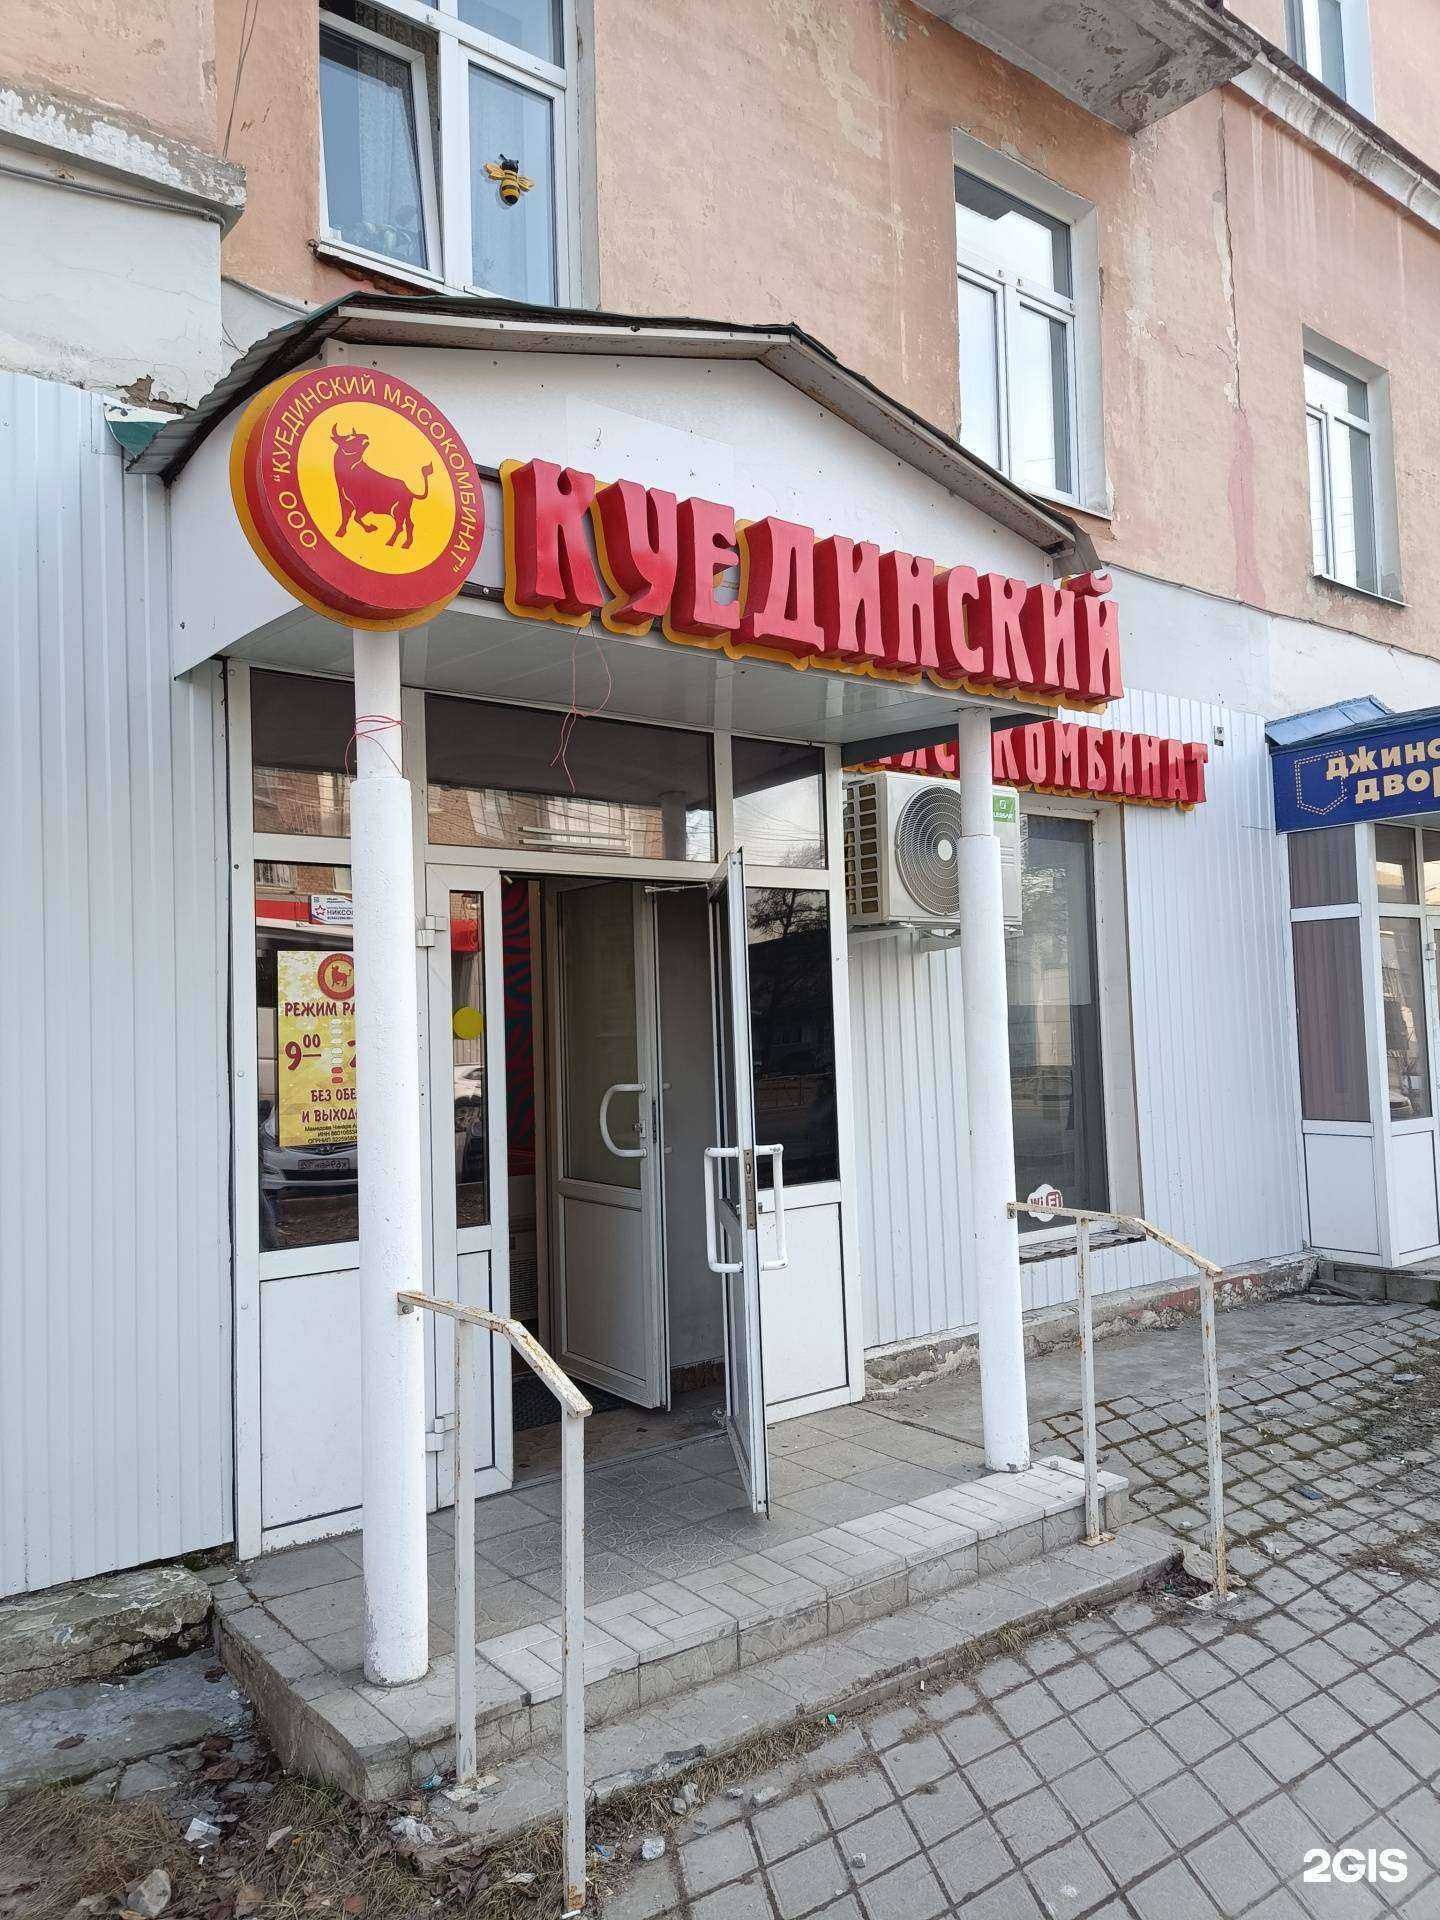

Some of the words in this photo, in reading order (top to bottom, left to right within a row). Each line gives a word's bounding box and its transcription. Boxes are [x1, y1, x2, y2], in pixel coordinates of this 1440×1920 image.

[279, 491, 318, 549] ООО
[512, 457, 1124, 701] КУЕДИНСКИЙ
[284, 1002, 338, 1017] РЕЖИМ
[311, 1088, 332, 1102] БЕЗ
[301, 1110, 310, 1123] И
[313, 1107, 358, 1122] ВЫХОД
